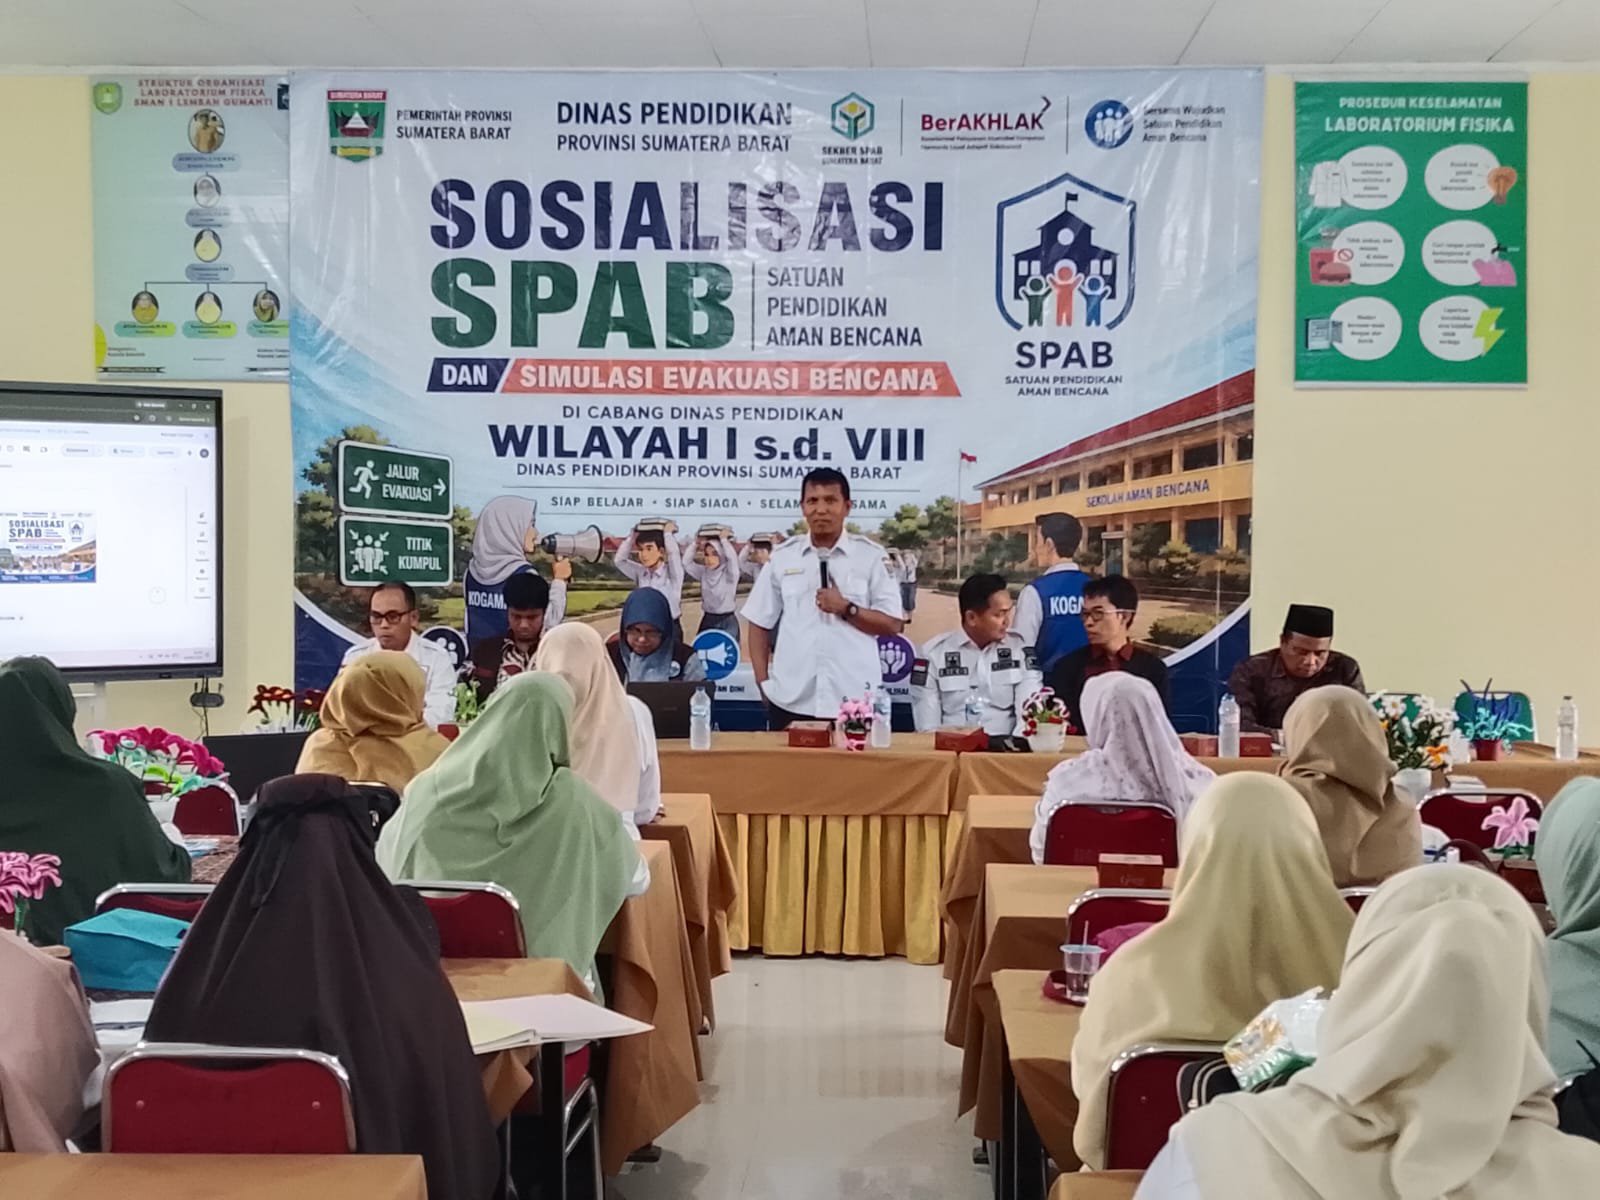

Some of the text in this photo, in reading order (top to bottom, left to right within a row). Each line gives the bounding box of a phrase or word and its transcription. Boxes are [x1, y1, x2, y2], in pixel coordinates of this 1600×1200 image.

[140, 88, 265, 97] LABORATORIUM FISIKA
[134, 98, 165, 107] SMAN
[1339, 96, 1503, 110] PROSEDUR KESELAMATAN
[396, 109, 512, 122] PEMERINTAH PROVINSI
[557, 101, 792, 126] DINAS PENDIDIKAN
[921, 112, 1045, 131] BerAKHLAK
[396, 126, 511, 140] SUMATERA BARAT
[1324, 116, 1516, 133] LABORATORIUM FISIKA
[557, 134, 791, 152] PROVINSI SUMATERA BARAT
[429, 178, 944, 253] SOSIALISASI
[767, 266, 844, 288] SATUAN
[429, 257, 735, 351] SPAB
[766, 296, 888, 318] PENDIDIKAN
[766, 326, 924, 348] AMAN BENCANA
[1015, 341, 1114, 369] SPAB
[442, 367, 489, 387] DAN
[520, 365, 939, 392] SIMULASI EVAKUASI BENCANA
[1005, 375, 1123, 385] SATUAN PENDIDIKAN
[1017, 387, 1109, 397] AMAN BENCANA
[562, 406, 844, 422] DI CABANG DINAS PENDIDIKAN
[487, 424, 926, 462] WILAYAH I s.d. VIII
[385, 463, 420, 481] JALUR
[516, 462, 566, 477] DINAS
[571, 463, 671, 478] PENDIDIKAN
[676, 464, 753, 479] PROVINSI
[850, 466, 903, 480] BARAT
[382, 483, 433, 503] EVAKUASI
[1126, 487, 1153, 502] AMAN
[1155, 478, 1210, 499] BENCANA
[550, 496, 581, 508] SIAP
[586, 497, 644, 508] BELAJAR
[664, 497, 695, 509] SIAP
[699, 498, 739, 509] SIAGA
[8, 519, 65, 528] SOSIALISASI
[8, 528, 43, 538] SPAB
[405, 536, 433, 551] TITIK
[398, 555, 442, 571] KUMPUL
